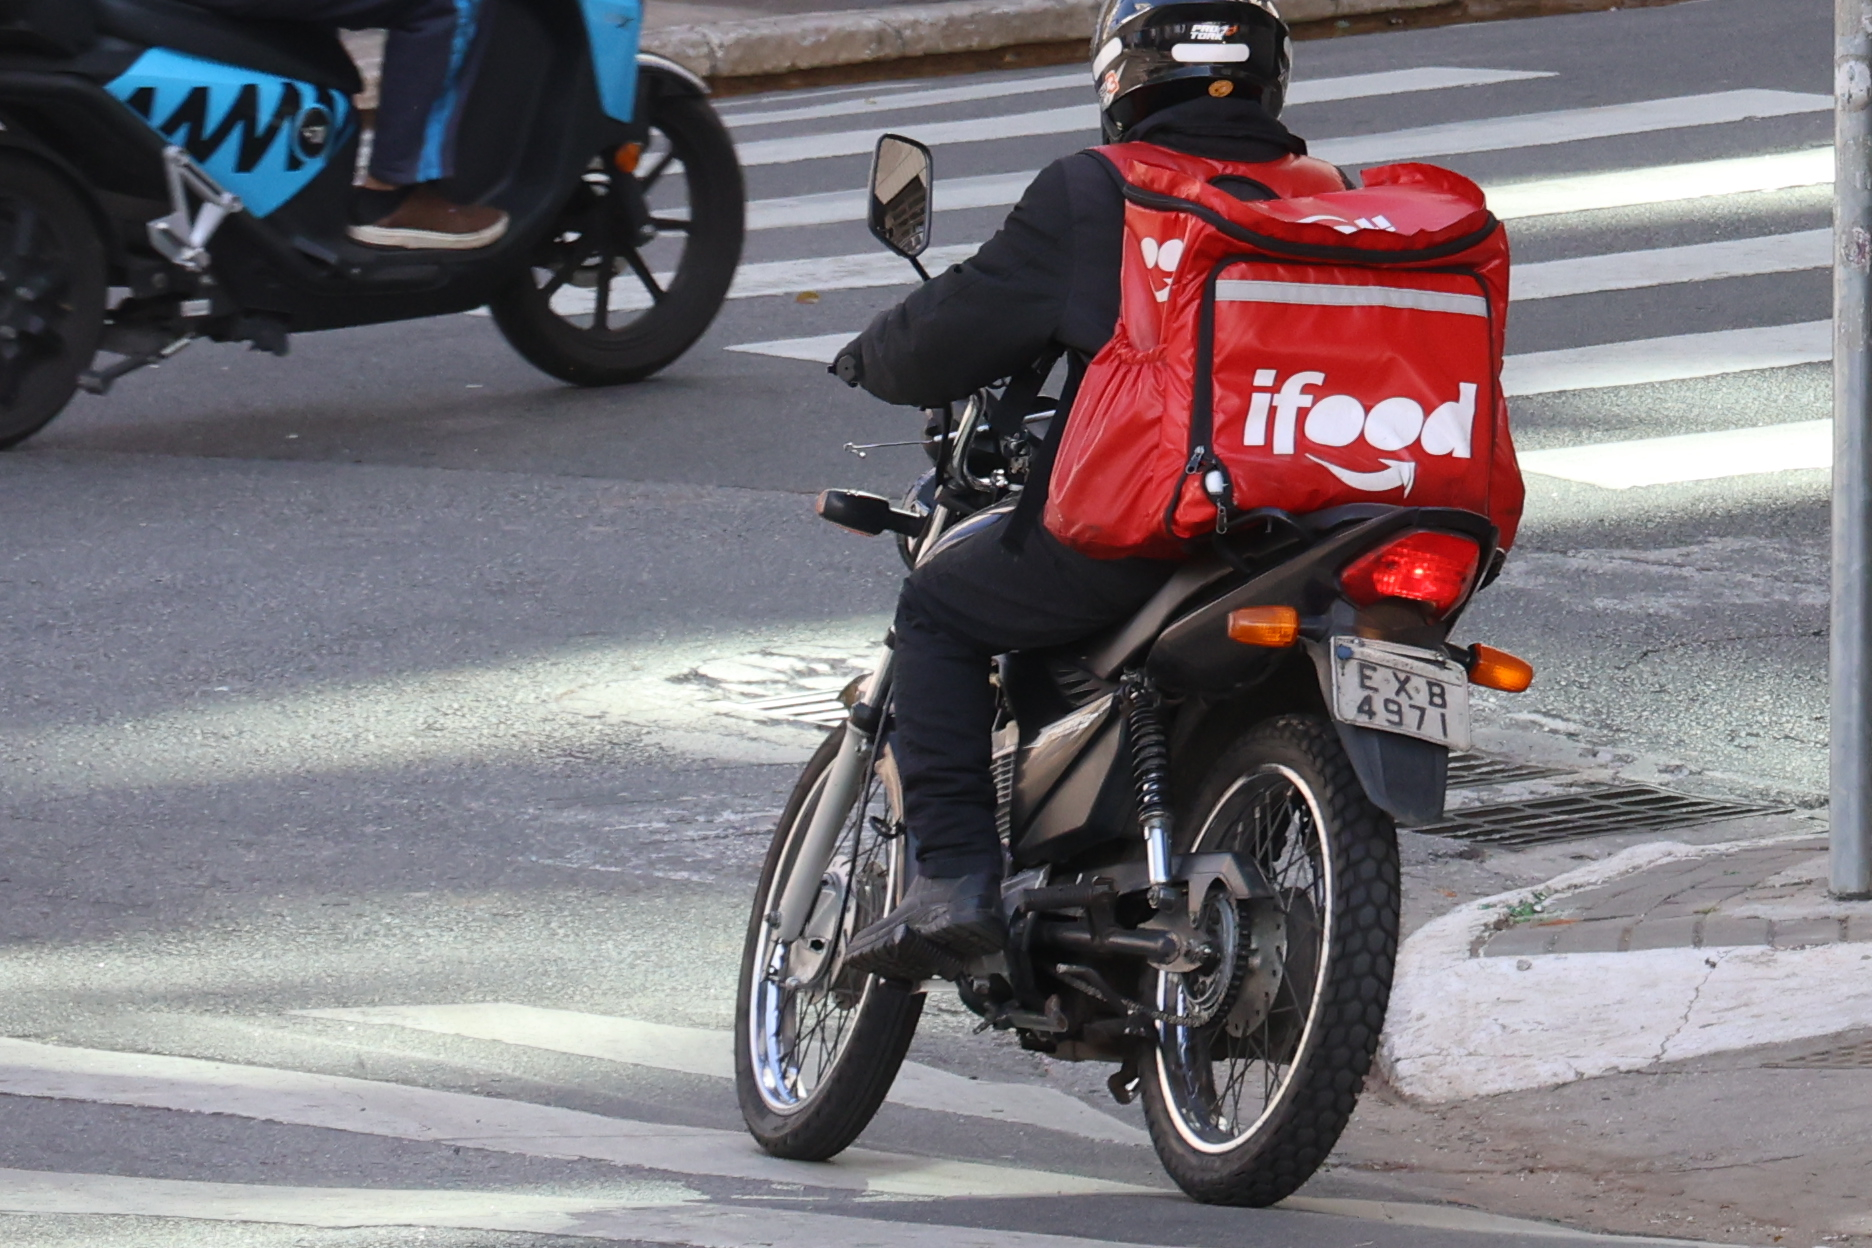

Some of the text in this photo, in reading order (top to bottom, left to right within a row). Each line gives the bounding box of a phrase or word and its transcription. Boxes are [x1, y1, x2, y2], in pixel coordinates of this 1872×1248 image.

[1191, 24, 1223, 33] PRO
[1190, 32, 1223, 41] TORK
[1243, 368, 1478, 458] ifood
